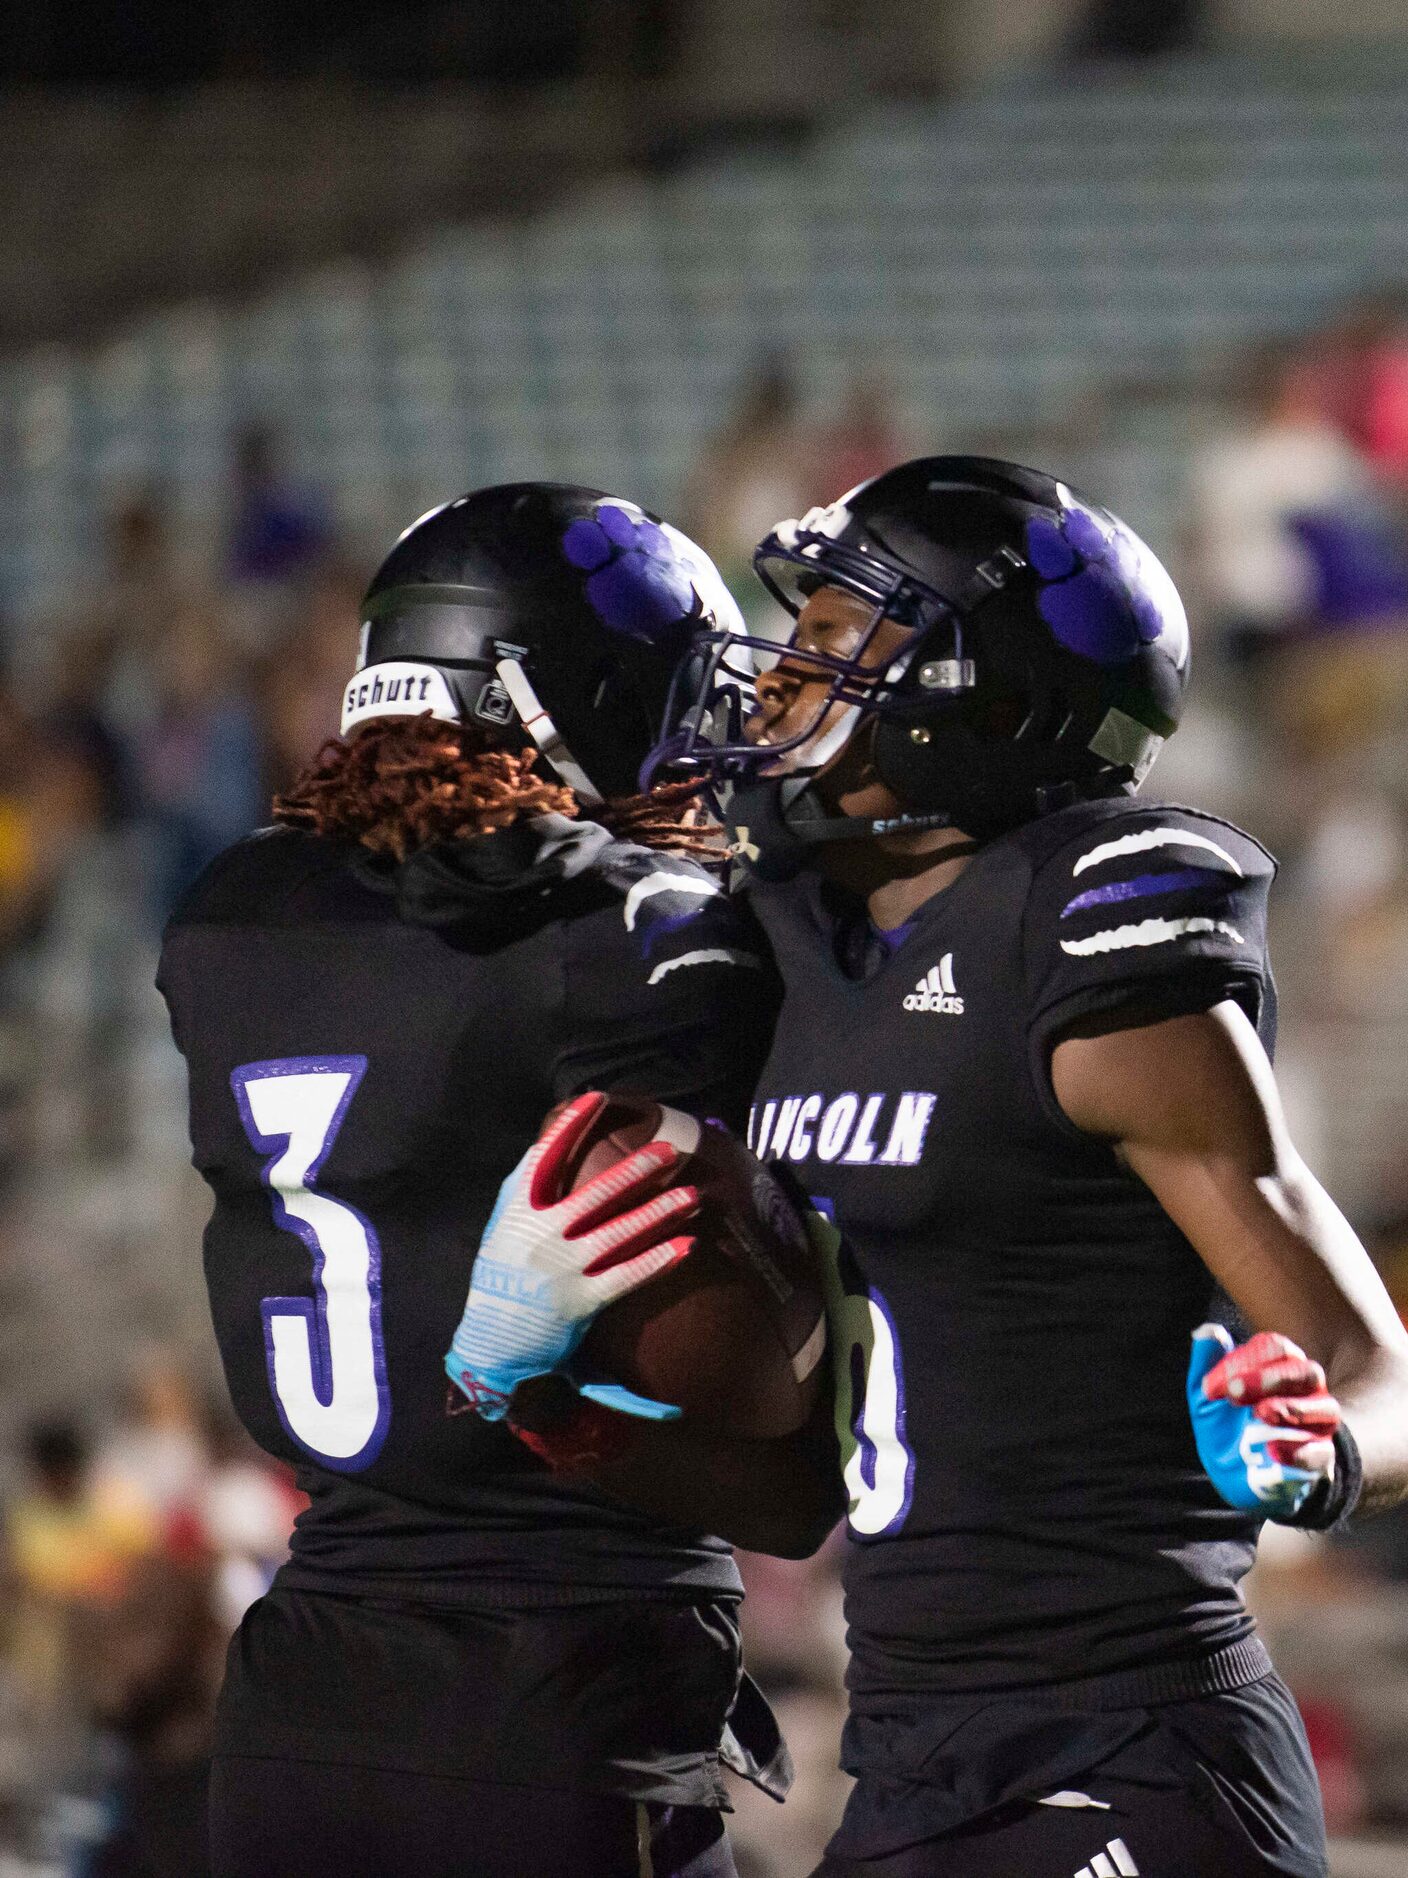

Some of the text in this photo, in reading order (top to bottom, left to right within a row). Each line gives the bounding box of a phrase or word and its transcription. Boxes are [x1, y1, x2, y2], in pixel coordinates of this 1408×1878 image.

[347, 674, 432, 713] schutt
[902, 989, 965, 1015] adidas
[230, 1054, 392, 1472] 3
